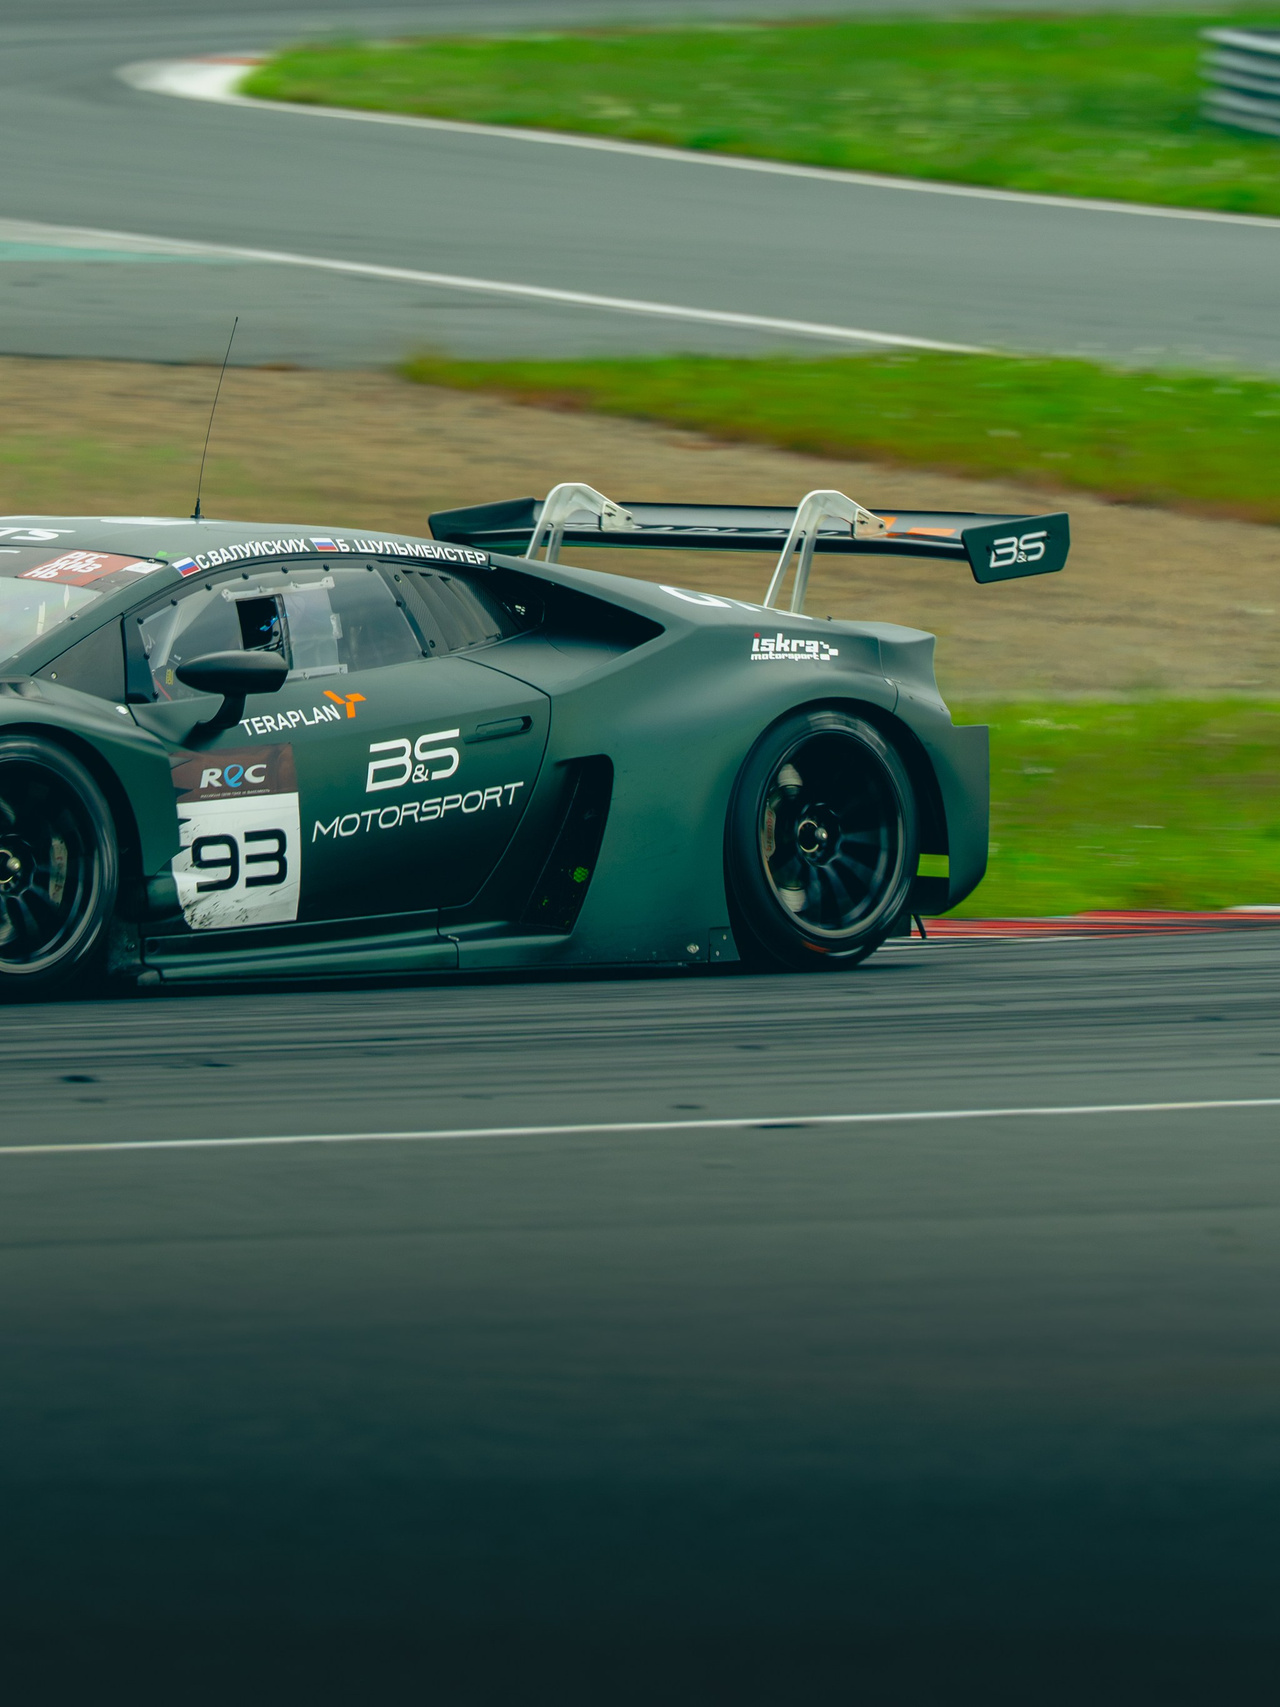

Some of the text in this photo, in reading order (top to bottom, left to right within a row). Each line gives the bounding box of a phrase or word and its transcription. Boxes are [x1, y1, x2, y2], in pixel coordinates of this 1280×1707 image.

[989, 530, 1048, 568] B&S
[751, 632, 819, 653] iskra
[239, 704, 341, 736] TERAPLAN
[365, 728, 460, 793] B&S
[311, 782, 524, 842] MOTORSPORT
[191, 828, 288, 893] 93
